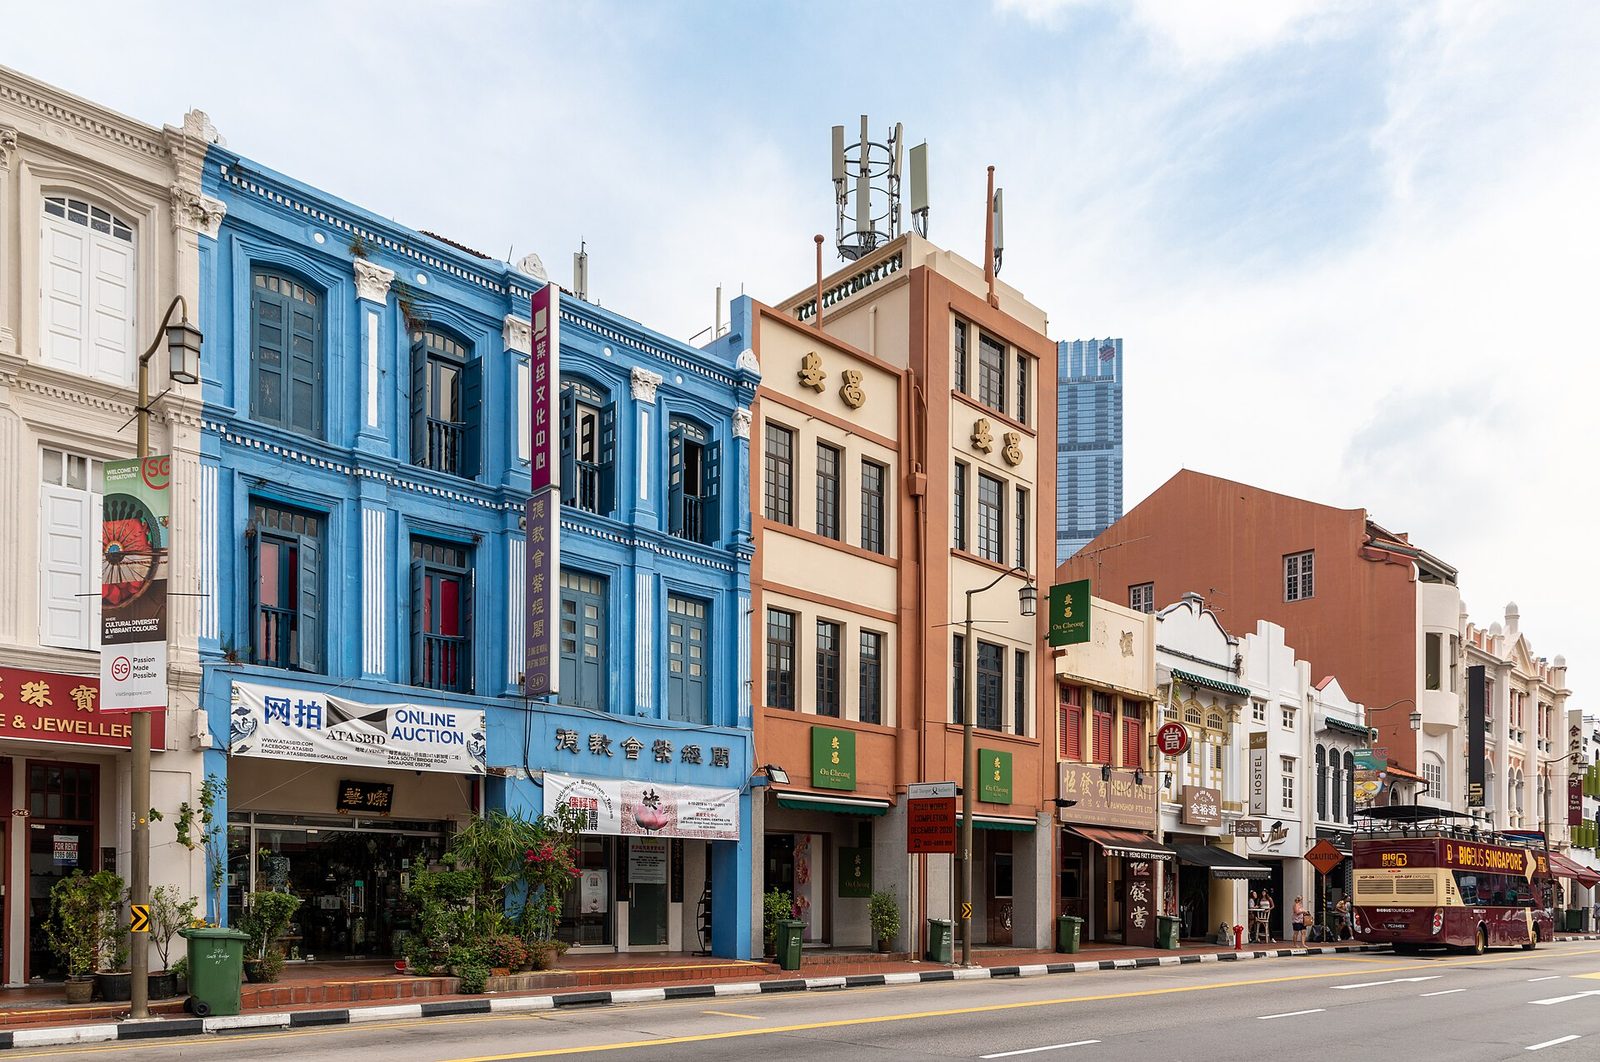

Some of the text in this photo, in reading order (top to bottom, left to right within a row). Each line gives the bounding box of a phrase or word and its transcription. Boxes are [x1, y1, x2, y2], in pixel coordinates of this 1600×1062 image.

[535, 341, 546, 471] 紫经文化中心
[531, 500, 545, 638] 德教會紫經閣
[105, 620, 132, 628] CULTURAL
[110, 626, 132, 634] VIBRANT
[531, 675, 544, 688] 249
[0, 676, 99, 713] 珠寶
[264, 695, 323, 731] 网拍
[395, 709, 456, 728] ONLINE
[12, 715, 26, 729] &
[32, 717, 132, 738] JEWELLER
[391, 727, 464, 745] AUCTION
[326, 730, 386, 745] ATASBID
[1163, 727, 1182, 751] 當
[556, 728, 731, 768] 德教會紫經閣
[1111, 780, 1153, 800] HENG FATT
[1110, 801, 1134, 811] PAWNSHOP
[1144, 806, 1153, 814] LTD
[54, 842, 78, 851] FOR RENT
[1309, 852, 1340, 861] CAUTION
[1485, 849, 1523, 870] SINGAPORE
